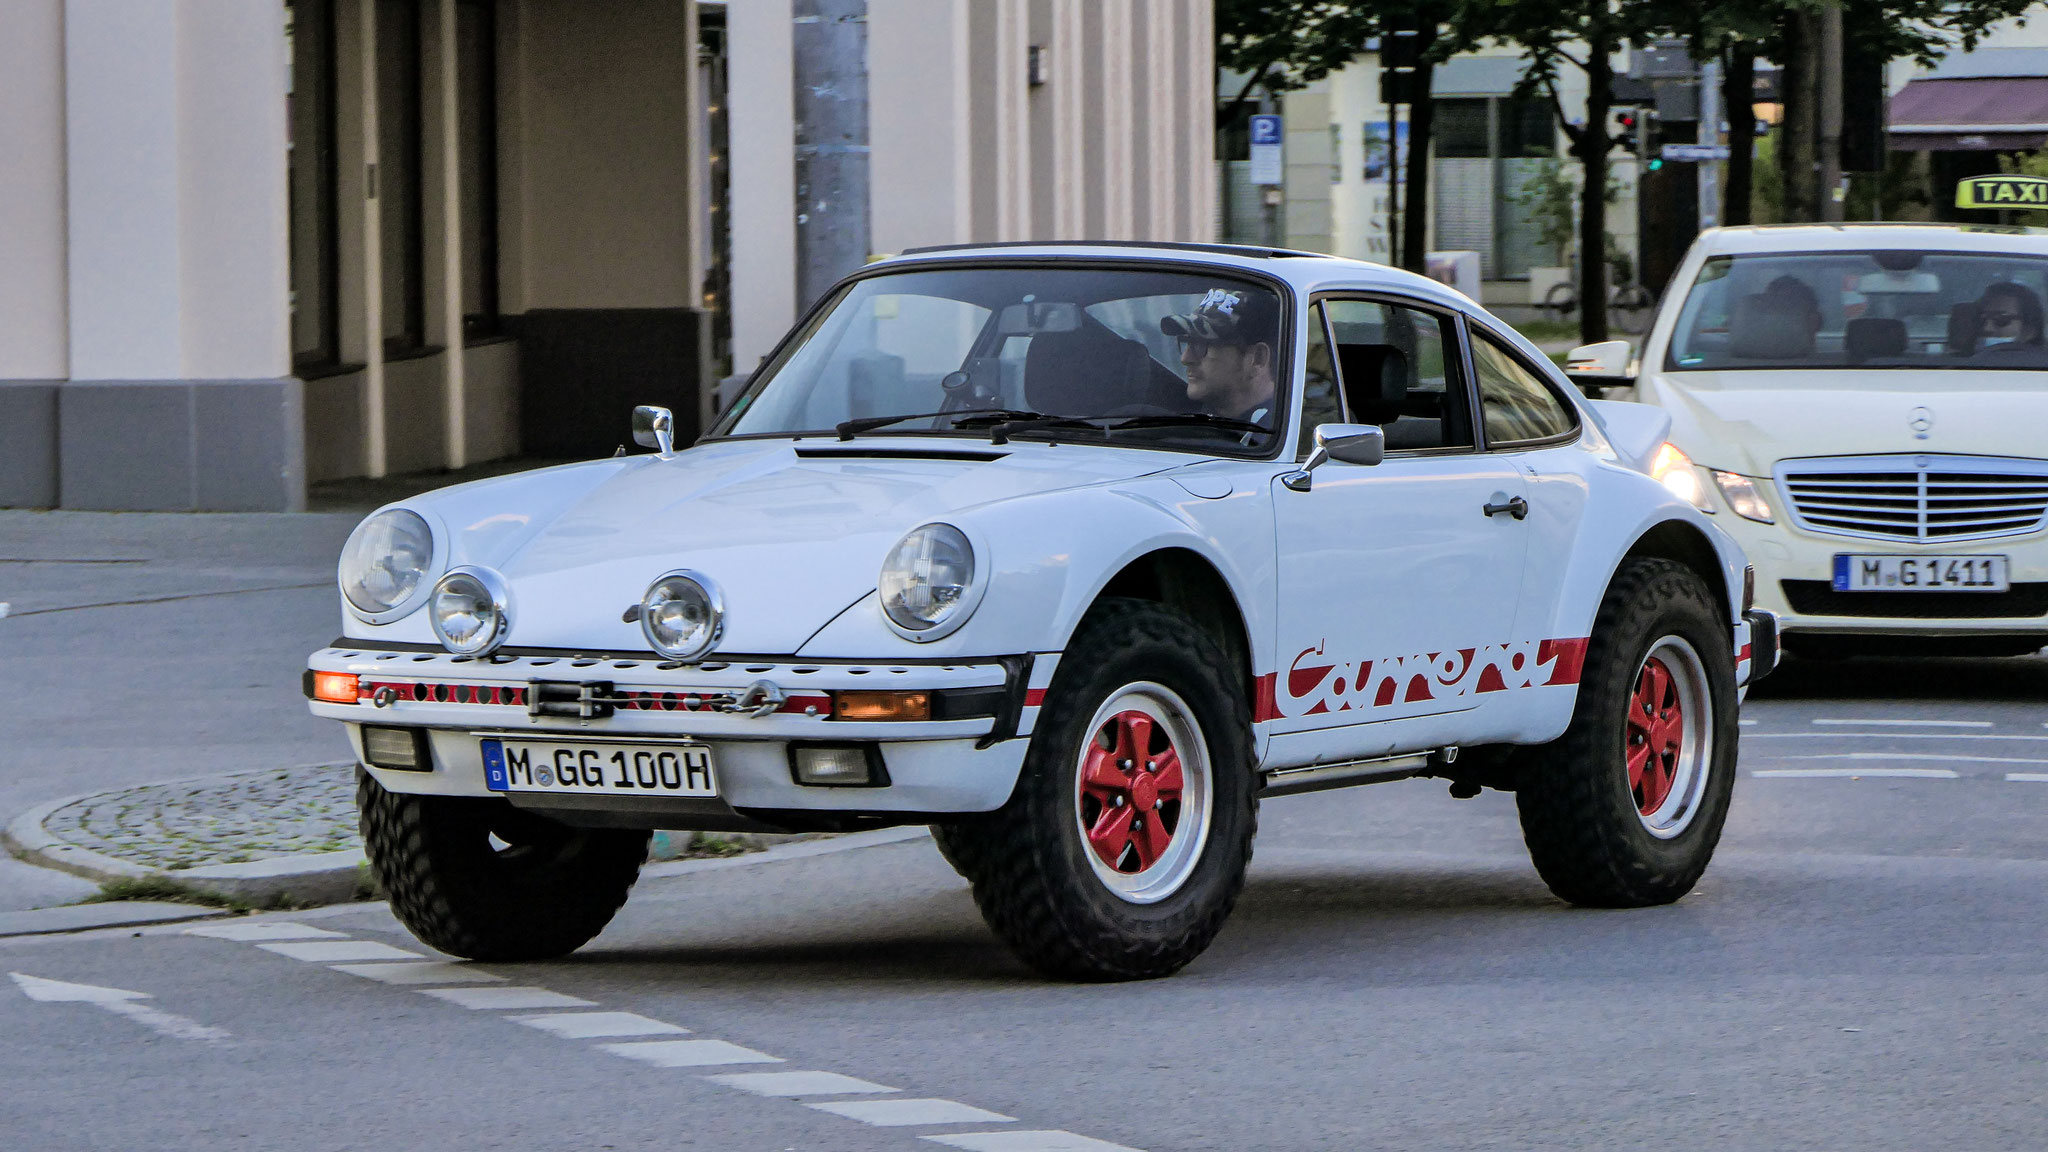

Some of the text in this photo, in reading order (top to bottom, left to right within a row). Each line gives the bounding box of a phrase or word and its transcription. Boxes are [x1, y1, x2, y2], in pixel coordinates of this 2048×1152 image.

[1255, 119, 1274, 140] P
[1976, 182, 2047, 202] TAXI
[1862, 560, 1881, 586] M
[1901, 560, 1918, 586] G
[1926, 560, 1994, 586] 1411
[1276, 638, 1558, 718] Carrera
[492, 770, 502, 782] D
[506, 747, 532, 785] M
[553, 749, 604, 787] GG
